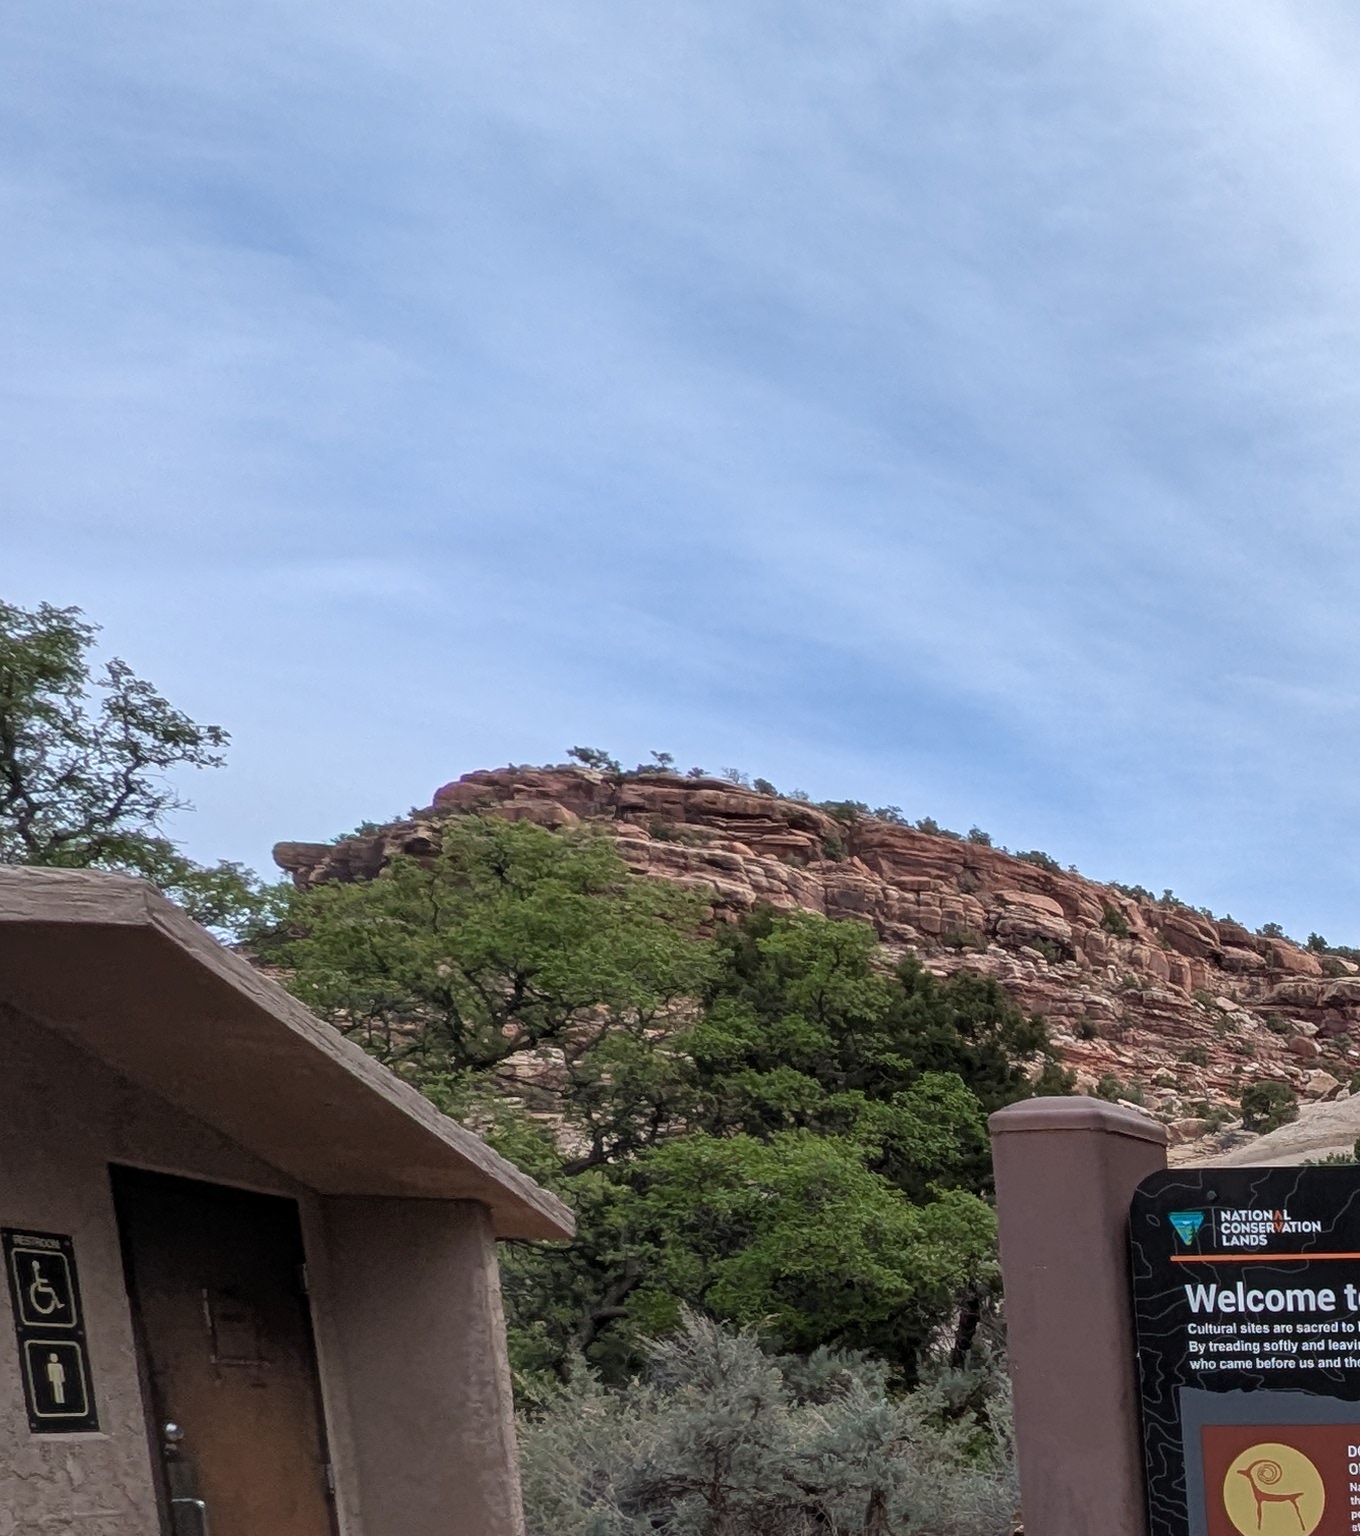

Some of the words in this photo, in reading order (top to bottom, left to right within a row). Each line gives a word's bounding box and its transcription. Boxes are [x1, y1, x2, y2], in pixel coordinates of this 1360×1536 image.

[1220, 1209, 1292, 1221] NATIONAL
[1220, 1221, 1322, 1234] CONSERVATION
[1221, 1233, 1268, 1246] LANDS
[1184, 1279, 1336, 1313] Welcome
[1187, 1322, 1237, 1334] Cultural
[1240, 1322, 1270, 1334] sites
[1273, 1324, 1293, 1333] are
[1296, 1321, 1338, 1333] sacred
[1341, 1321, 1355, 1332] to
[1188, 1340, 1206, 1355] By
[1208, 1339, 1260, 1354] treading
[1262, 1338, 1298, 1353] softly
[1301, 1339, 1325, 1351] and
[1189, 1357, 1216, 1370] who
[1219, 1359, 1252, 1369] came
[1255, 1356, 1296, 1369] before
[1298, 1359, 1315, 1369] us
[1317, 1356, 1341, 1368] and
